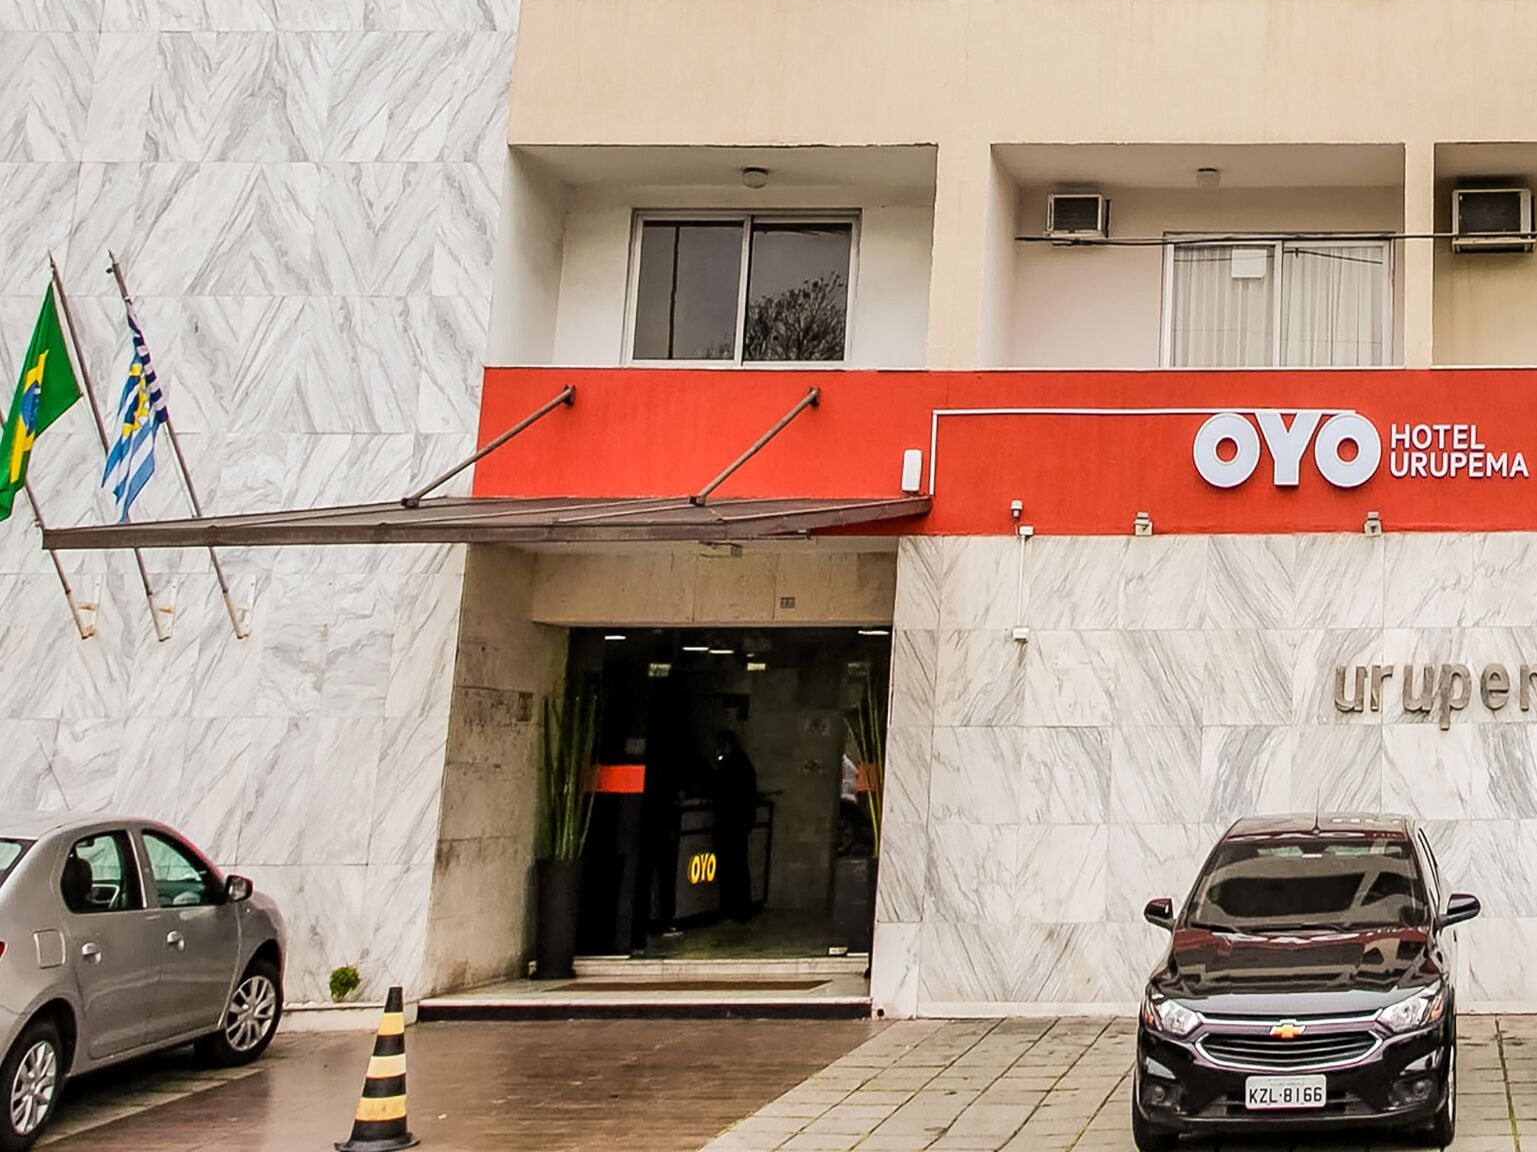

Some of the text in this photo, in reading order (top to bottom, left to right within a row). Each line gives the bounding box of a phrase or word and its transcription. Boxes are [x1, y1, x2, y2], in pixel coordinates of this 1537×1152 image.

[1193, 412, 1382, 488] OYO
[1390, 424, 1486, 450] HOTEL
[1390, 452, 1530, 478] URUPEMA
[690, 853, 717, 885] OYO
